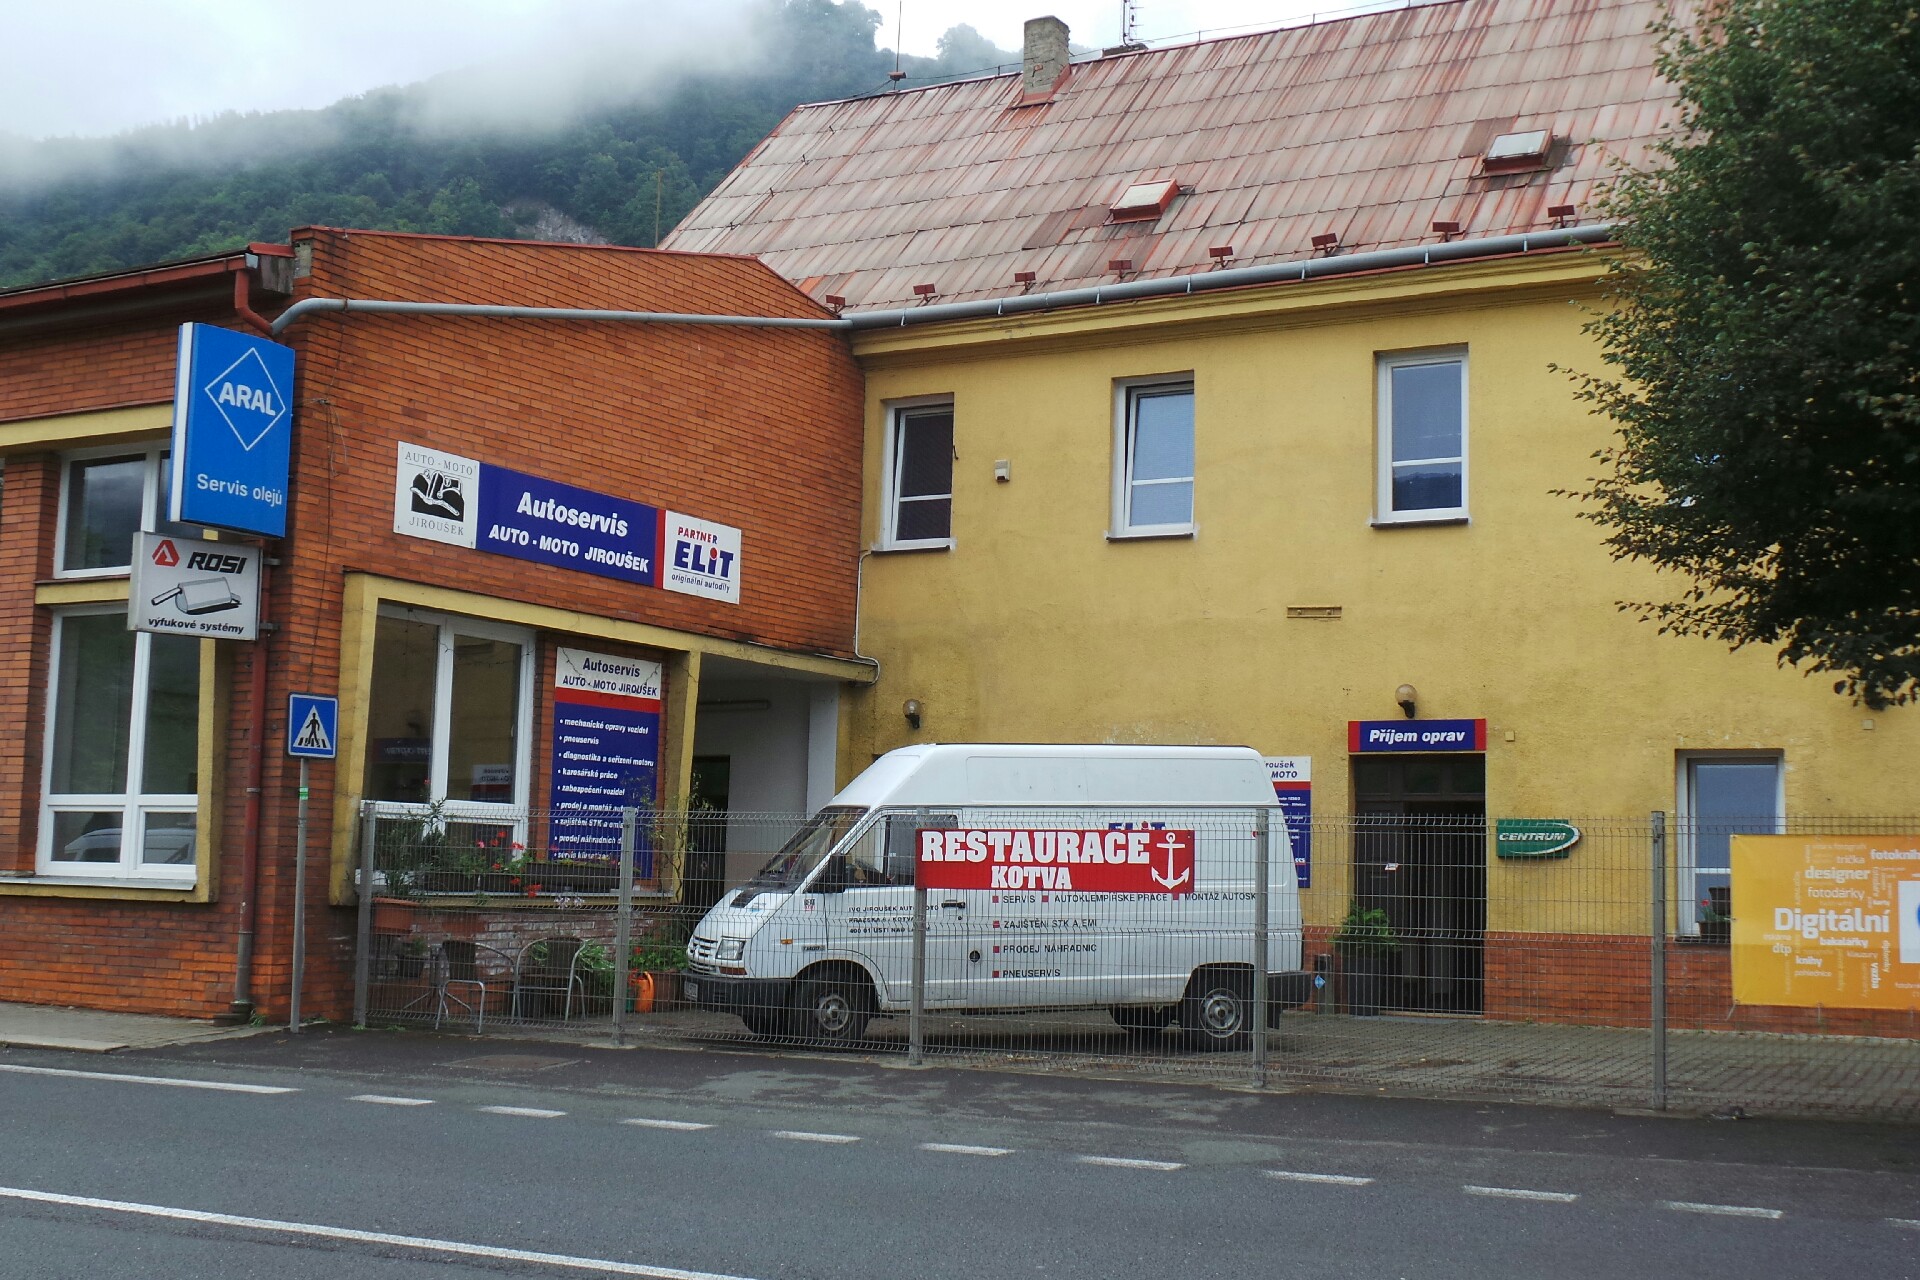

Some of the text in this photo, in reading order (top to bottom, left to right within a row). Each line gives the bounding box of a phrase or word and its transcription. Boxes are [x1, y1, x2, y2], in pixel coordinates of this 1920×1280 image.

[218, 381, 276, 416] ARAL
[405, 450, 435, 466] AUTO
[443, 460, 473, 476] MOTO
[197, 473, 283, 507] Servis olejů
[516, 492, 628, 537] Autoservis
[409, 517, 464, 536] JIROUŠEK
[678, 527, 718, 545] PARTNER
[488, 524, 528, 546] AUTO
[539, 536, 579, 557] MOTO
[584, 546, 649, 574] JIROUŠEK
[187, 551, 247, 574] ROSI
[148, 617, 244, 634] výfukové systémy
[583, 657, 641, 678] Autoservis
[562, 675, 586, 688] AUTO
[593, 681, 616, 693] MOTO
[619, 682, 657, 697] JIROUŠEK
[564, 718, 649, 735] mechanické opravy vozidel
[563, 735, 599, 745] pneuservis
[1369, 728, 1466, 745] Příjem oprav
[563, 750, 601, 762] diagnostika
[1265, 760, 1295, 769] roušek
[599, 771, 618, 779] práce
[561, 784, 625, 796] zabezpečení vozidel
[560, 802, 582, 810] prodej
[588, 818, 602, 827] STK
[558, 835, 579, 843] prodej
[1499, 832, 1567, 841] CENTRUM
[921, 830, 1150, 864] RESTAURACE
[991, 866, 1072, 890] KOTVA
[1804, 865, 1871, 884] designer
[1003, 895, 1036, 904] SERVIS
[1222, 892, 1256, 901] AUTOSK
[1807, 886, 1866, 900] fotodárky
[1052, 919, 1069, 928] STK
[1775, 907, 1891, 939] Digitální
[1003, 945, 1040, 954] PRODEJ
[1772, 943, 1792, 956] dtp
[1002, 969, 1061, 978] PNEUSERVIS
